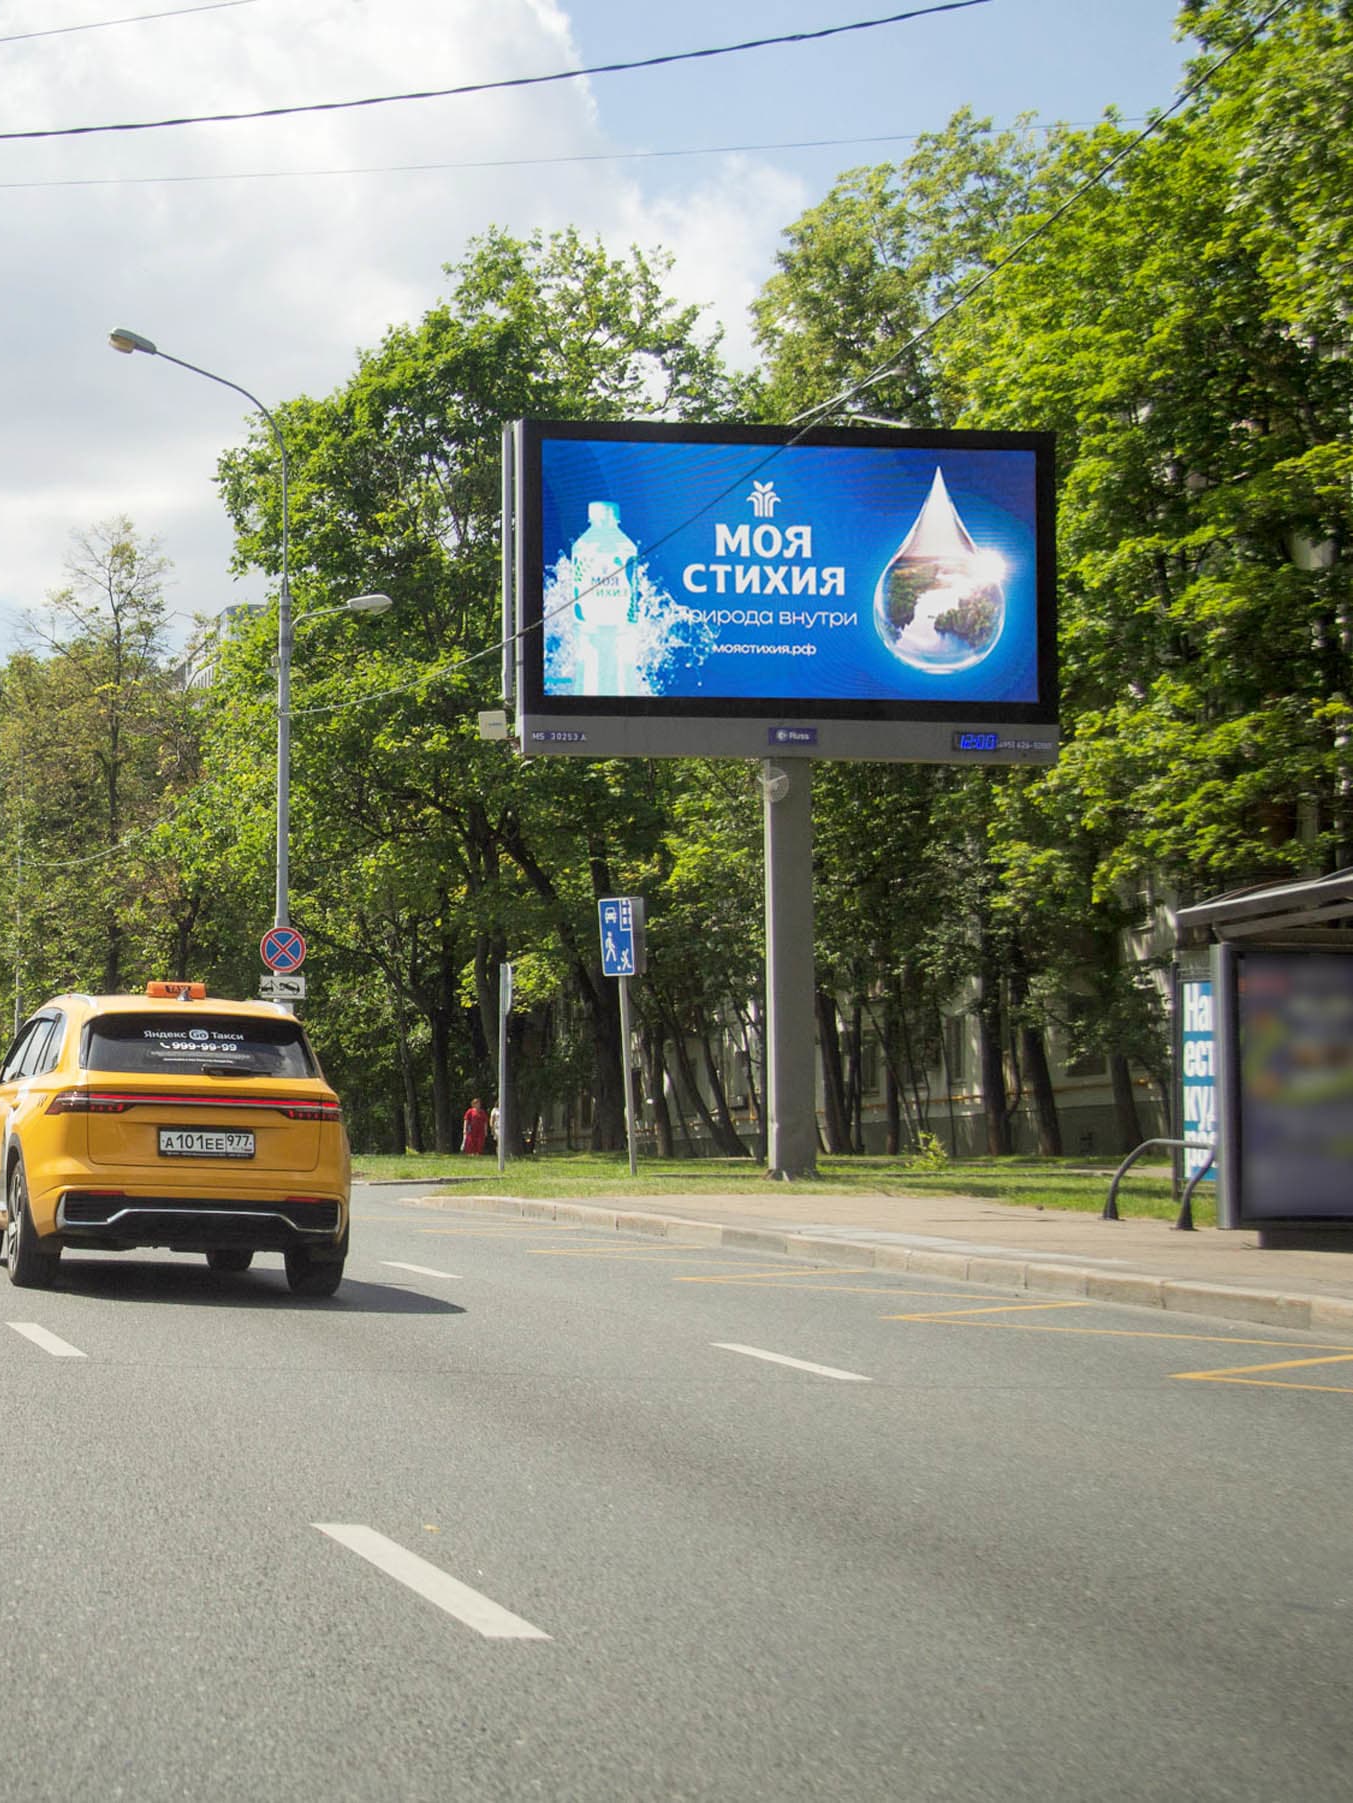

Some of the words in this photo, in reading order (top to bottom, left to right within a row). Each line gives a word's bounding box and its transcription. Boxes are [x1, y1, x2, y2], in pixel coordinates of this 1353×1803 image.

[715, 523, 812, 559] МОЯ
[682, 563, 846, 596] СТИХИЯ
[778, 610, 858, 629] внутри
[714, 642, 817, 657] моястихия.рф
[959, 733, 997, 750] 12:00
[143, 1029, 187, 1039] Яндекс
[210, 1031, 244, 1040] Такси
[171, 1041, 237, 1052] 999-99-99
[165, 1134, 225, 1150] А101ЕЕ
[227, 1135, 250, 1146] 977
